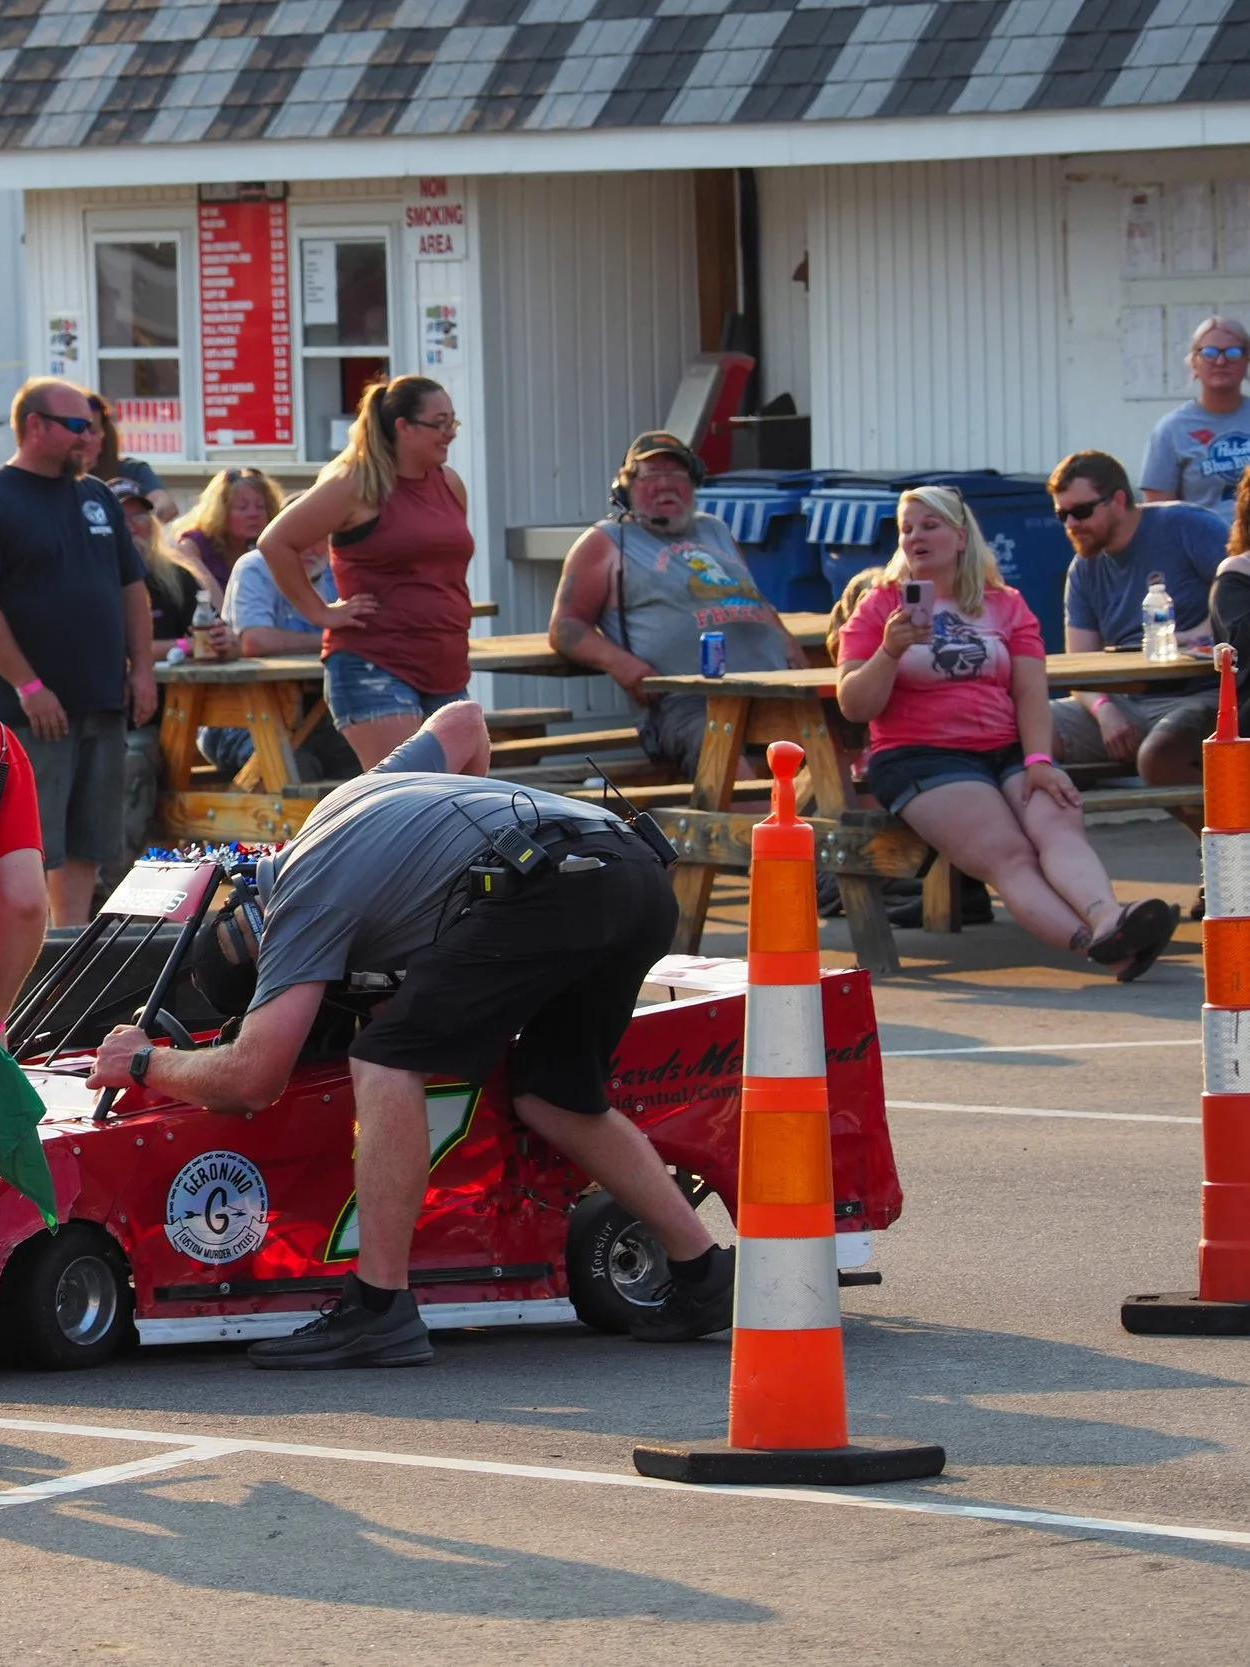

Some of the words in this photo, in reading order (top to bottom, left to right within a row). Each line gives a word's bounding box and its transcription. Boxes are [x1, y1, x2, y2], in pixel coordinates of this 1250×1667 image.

[419, 177, 447, 198] NON
[405, 204, 463, 228] SMOKING
[419, 234, 453, 254] AREA
[183, 1162, 254, 1196] GERONIMO
[205, 1186, 229, 1235] G
[179, 1232, 204, 1257] CUSTOM
[203, 1248, 232, 1260] MURDER
[233, 1231, 256, 1255] CYCLES
